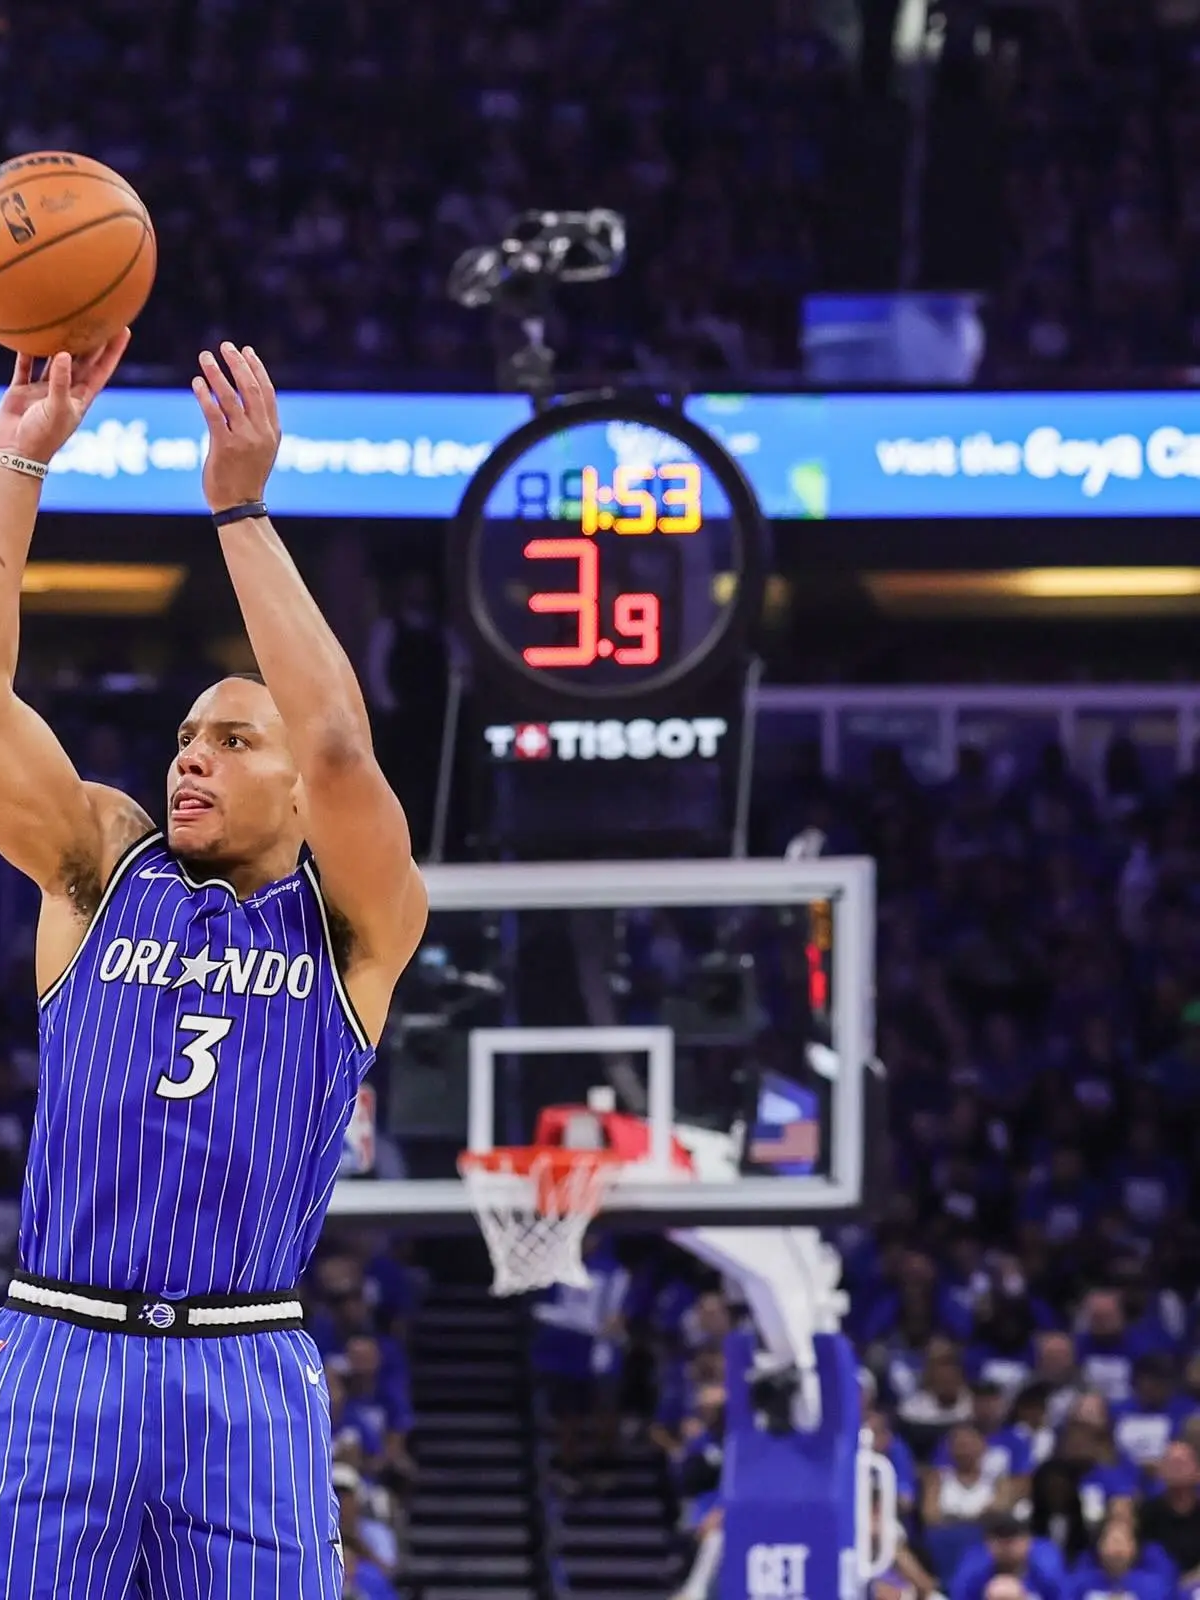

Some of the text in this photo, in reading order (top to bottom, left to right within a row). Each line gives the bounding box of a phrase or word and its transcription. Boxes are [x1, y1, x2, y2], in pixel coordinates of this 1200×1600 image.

[12, 456, 25, 469] Up
[581, 463, 702, 535] 1:53
[523, 538, 660, 666] 3.9
[550, 718, 727, 760] TISSOT
[155, 1014, 233, 1099] 3
